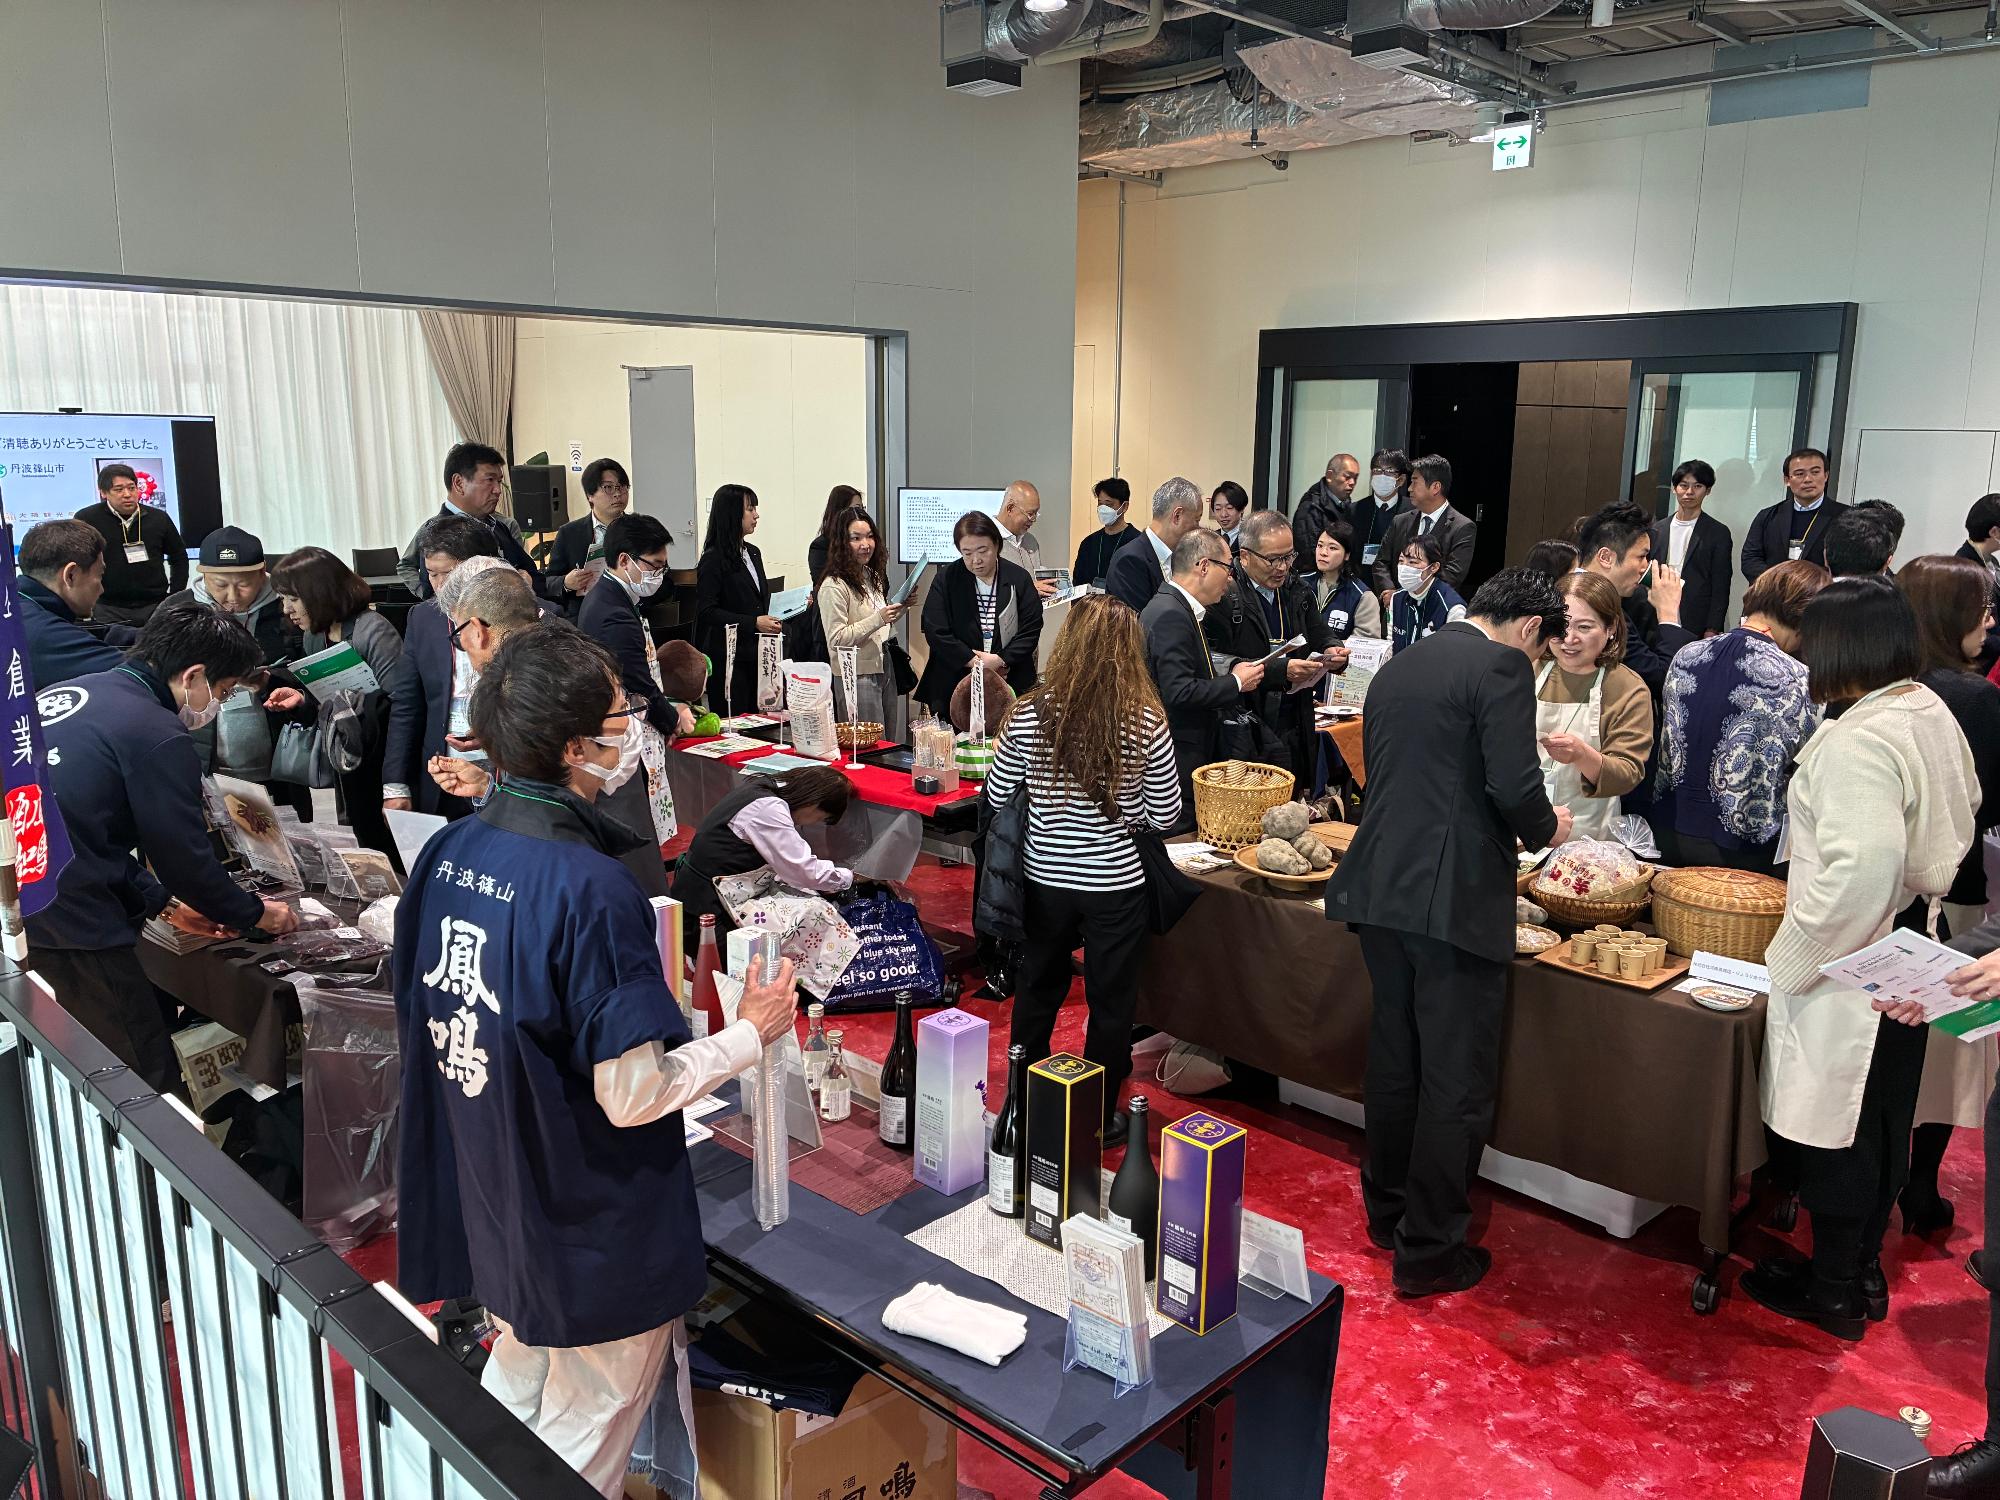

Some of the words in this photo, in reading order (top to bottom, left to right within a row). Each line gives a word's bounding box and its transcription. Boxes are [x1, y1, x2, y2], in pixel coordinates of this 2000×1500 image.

[0, 437, 158, 450] 清聴ありがとうございました。
[10, 463, 65, 474] 丹波篠山市
[436, 860, 515, 903] 丹波篠山
[853, 922, 882, 934] leasant
[863, 949, 883, 959] blue
[885, 946, 899, 956] sky
[901, 944, 917, 953] and
[834, 970, 854, 987] eel
[859, 971, 876, 981] so
[880, 962, 920, 981] good.
[841, 993, 853, 1001] your
[423, 915, 500, 1098] 鳳鳴
